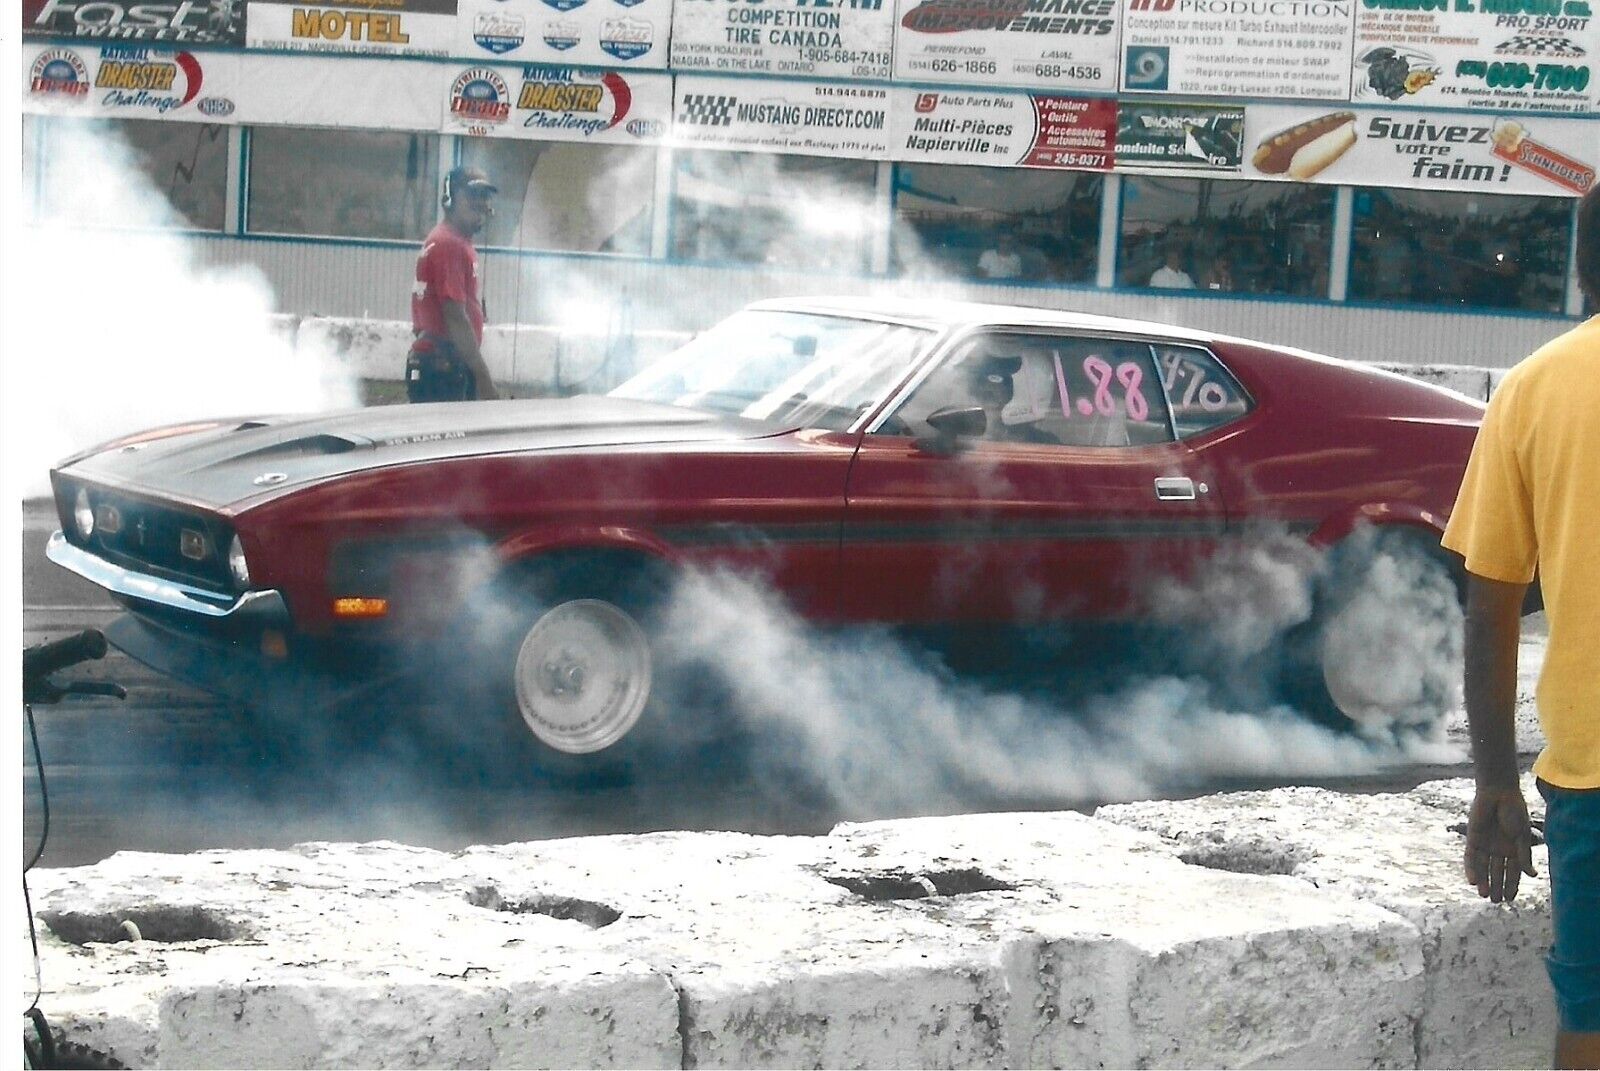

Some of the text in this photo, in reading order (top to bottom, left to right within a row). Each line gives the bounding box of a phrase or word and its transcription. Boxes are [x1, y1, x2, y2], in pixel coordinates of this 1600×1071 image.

[1180, 0, 1349, 18] PRODUCTION
[292, 8, 410, 43] MOTEL
[727, 8, 840, 28] COMPETITION
[1128, 16, 1175, 31] Conception
[1177, 21, 1189, 30] sur
[1192, 21, 1222, 31] mesure
[1224, 20, 1237, 32] Kit
[1240, 19, 1262, 32] Turbo
[1264, 20, 1298, 33] Exhaust
[1496, 15, 1589, 31] PRO SPORT
[725, 27, 842, 48] TIRE CANADA
[1238, 37, 1274, 47] Richard
[101, 47, 150, 60] NATIONAL
[799, 49, 890, 66] 1-905-684-7418
[1252, 57, 1264, 65] de
[1266, 58, 1300, 67] moteur
[1302, 58, 1330, 66] SWAP
[672, 55, 815, 73] NIAGARA ON THE LAKE ONTARIO
[95, 61, 177, 90] DRAGSTER
[522, 67, 573, 81] NATIONAL
[102, 89, 181, 113] Challenge
[517, 82, 603, 112] DRAGSTER
[940, 95, 1013, 109] Auto Parts Plus
[1045, 99, 1089, 111] Peinture
[1511, 100, 1522, 108] de
[201, 99, 233, 116] NHRA
[524, 112, 609, 136] Challenge
[737, 104, 885, 130] MUSTANG DIRECT.COM
[1048, 112, 1078, 123] Outils
[914, 117, 1013, 136] Multi-Pièces
[1047, 125, 1106, 138] Accessoires
[1367, 117, 1490, 144] Suivez
[906, 135, 989, 154] Napierville
[1047, 136, 1106, 147] automobiles
[1114, 143, 1165, 155] onduite
[1395, 143, 1450, 156] votre
[1054, 152, 1106, 166] 245-0371
[1519, 143, 1592, 190] SCHNEIDERS
[1053, 349, 1149, 421] 1.88
